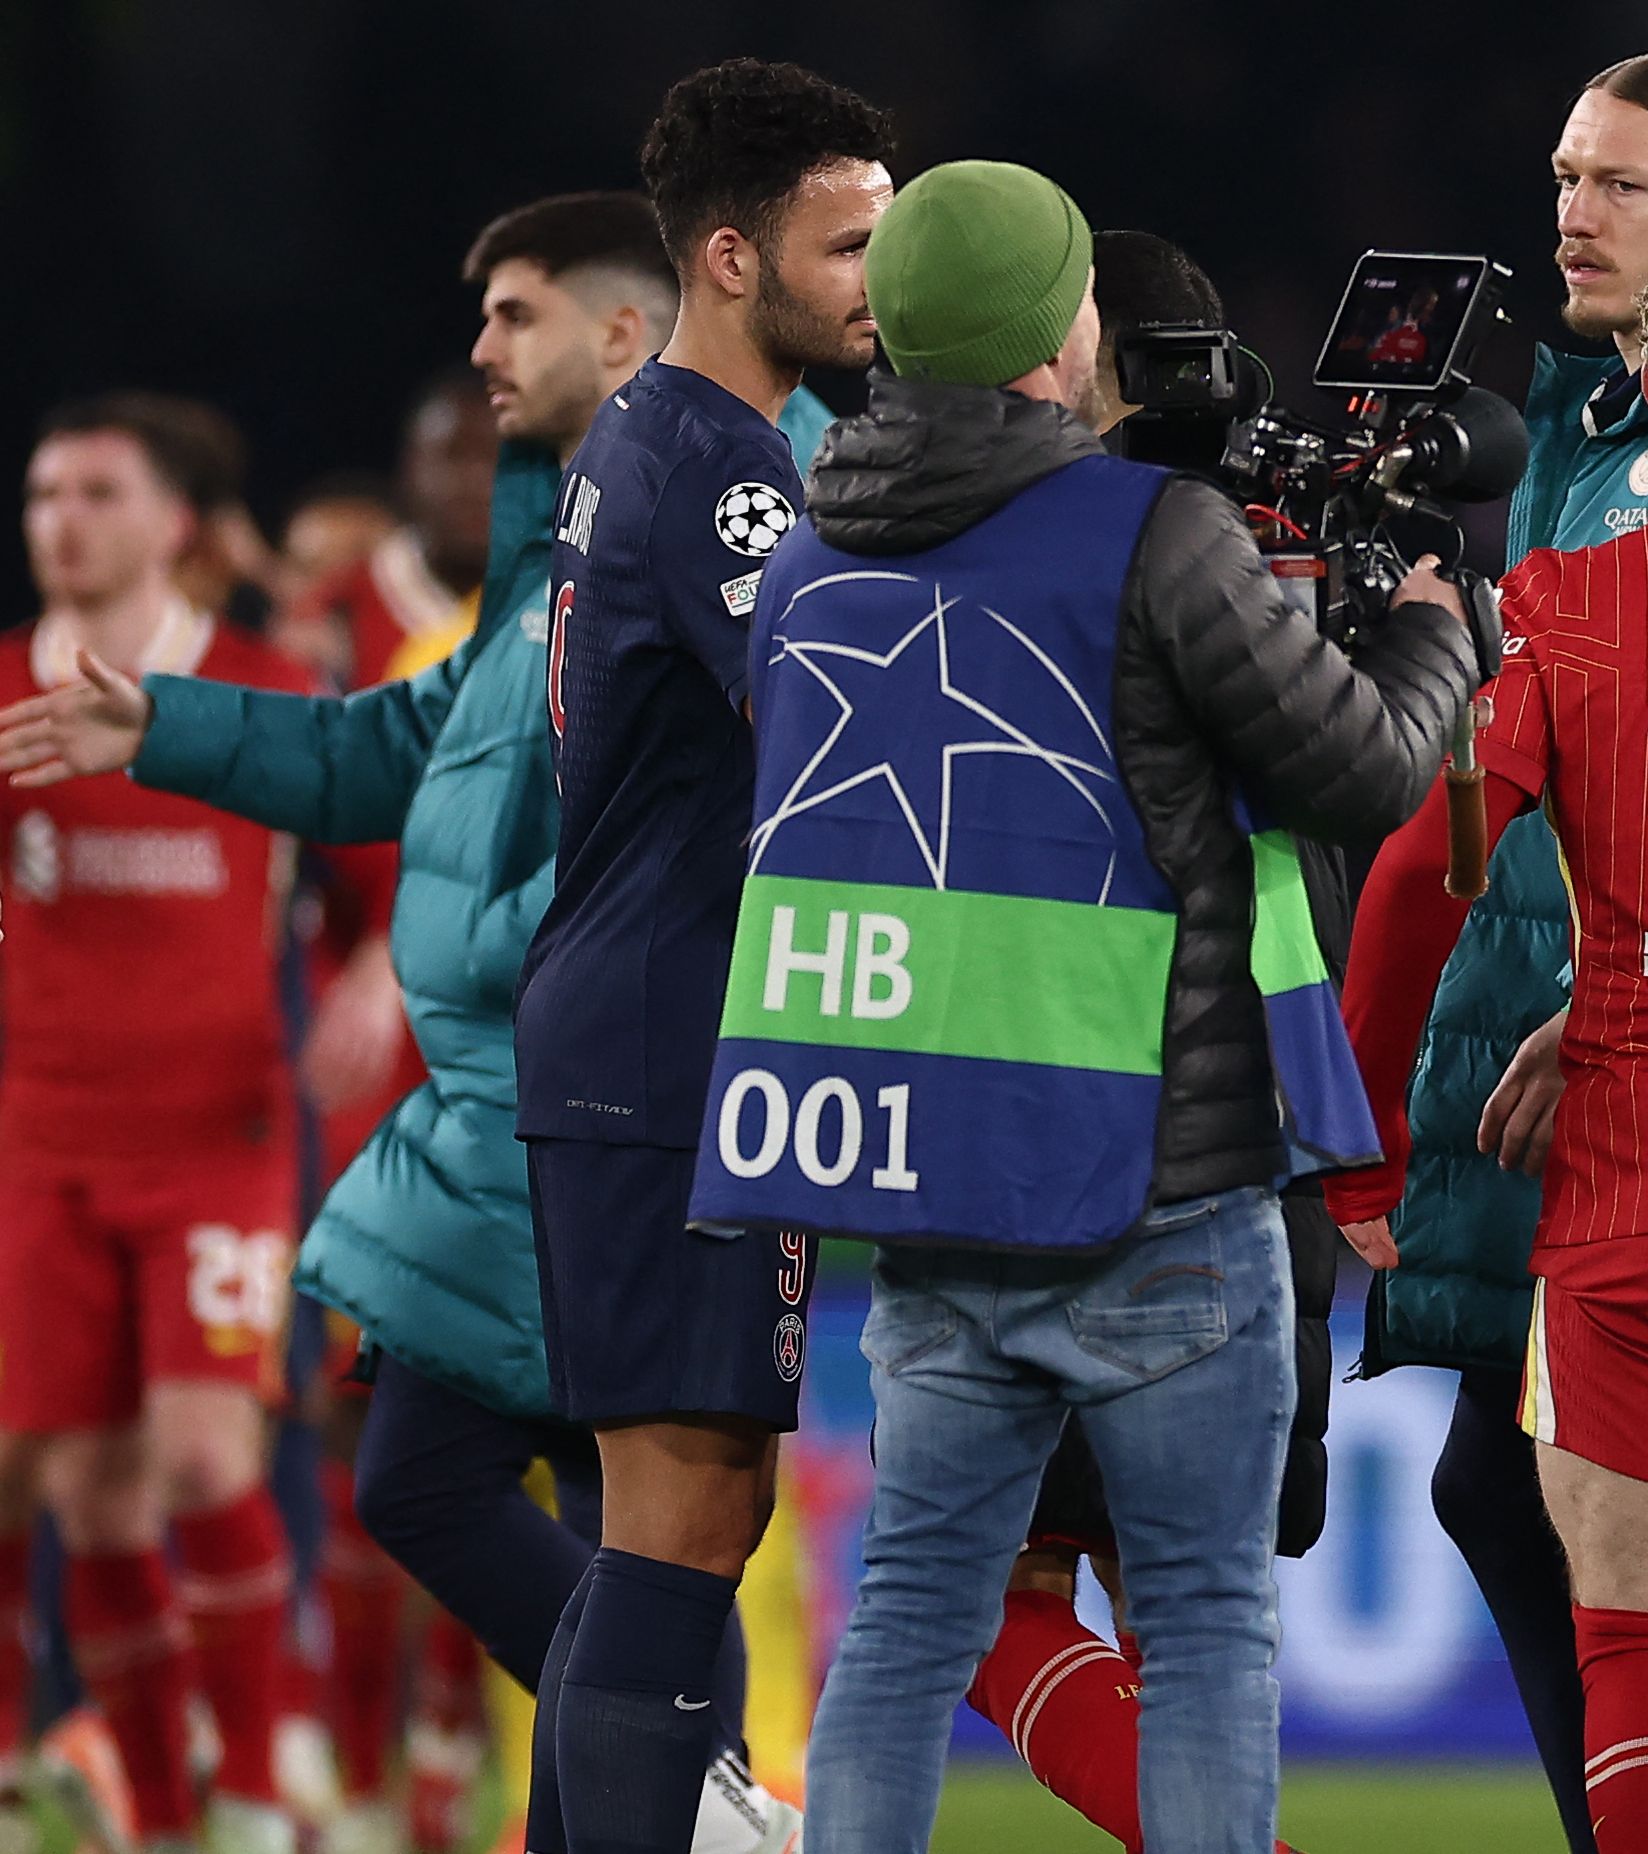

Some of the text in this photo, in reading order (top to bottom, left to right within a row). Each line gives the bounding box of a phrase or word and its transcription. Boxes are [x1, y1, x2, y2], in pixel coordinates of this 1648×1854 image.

[724, 579, 748, 594] UEFA
[761, 905, 913, 1020] HB
[717, 1068, 919, 1193] 001
[1114, 1684, 1144, 1700] LF
